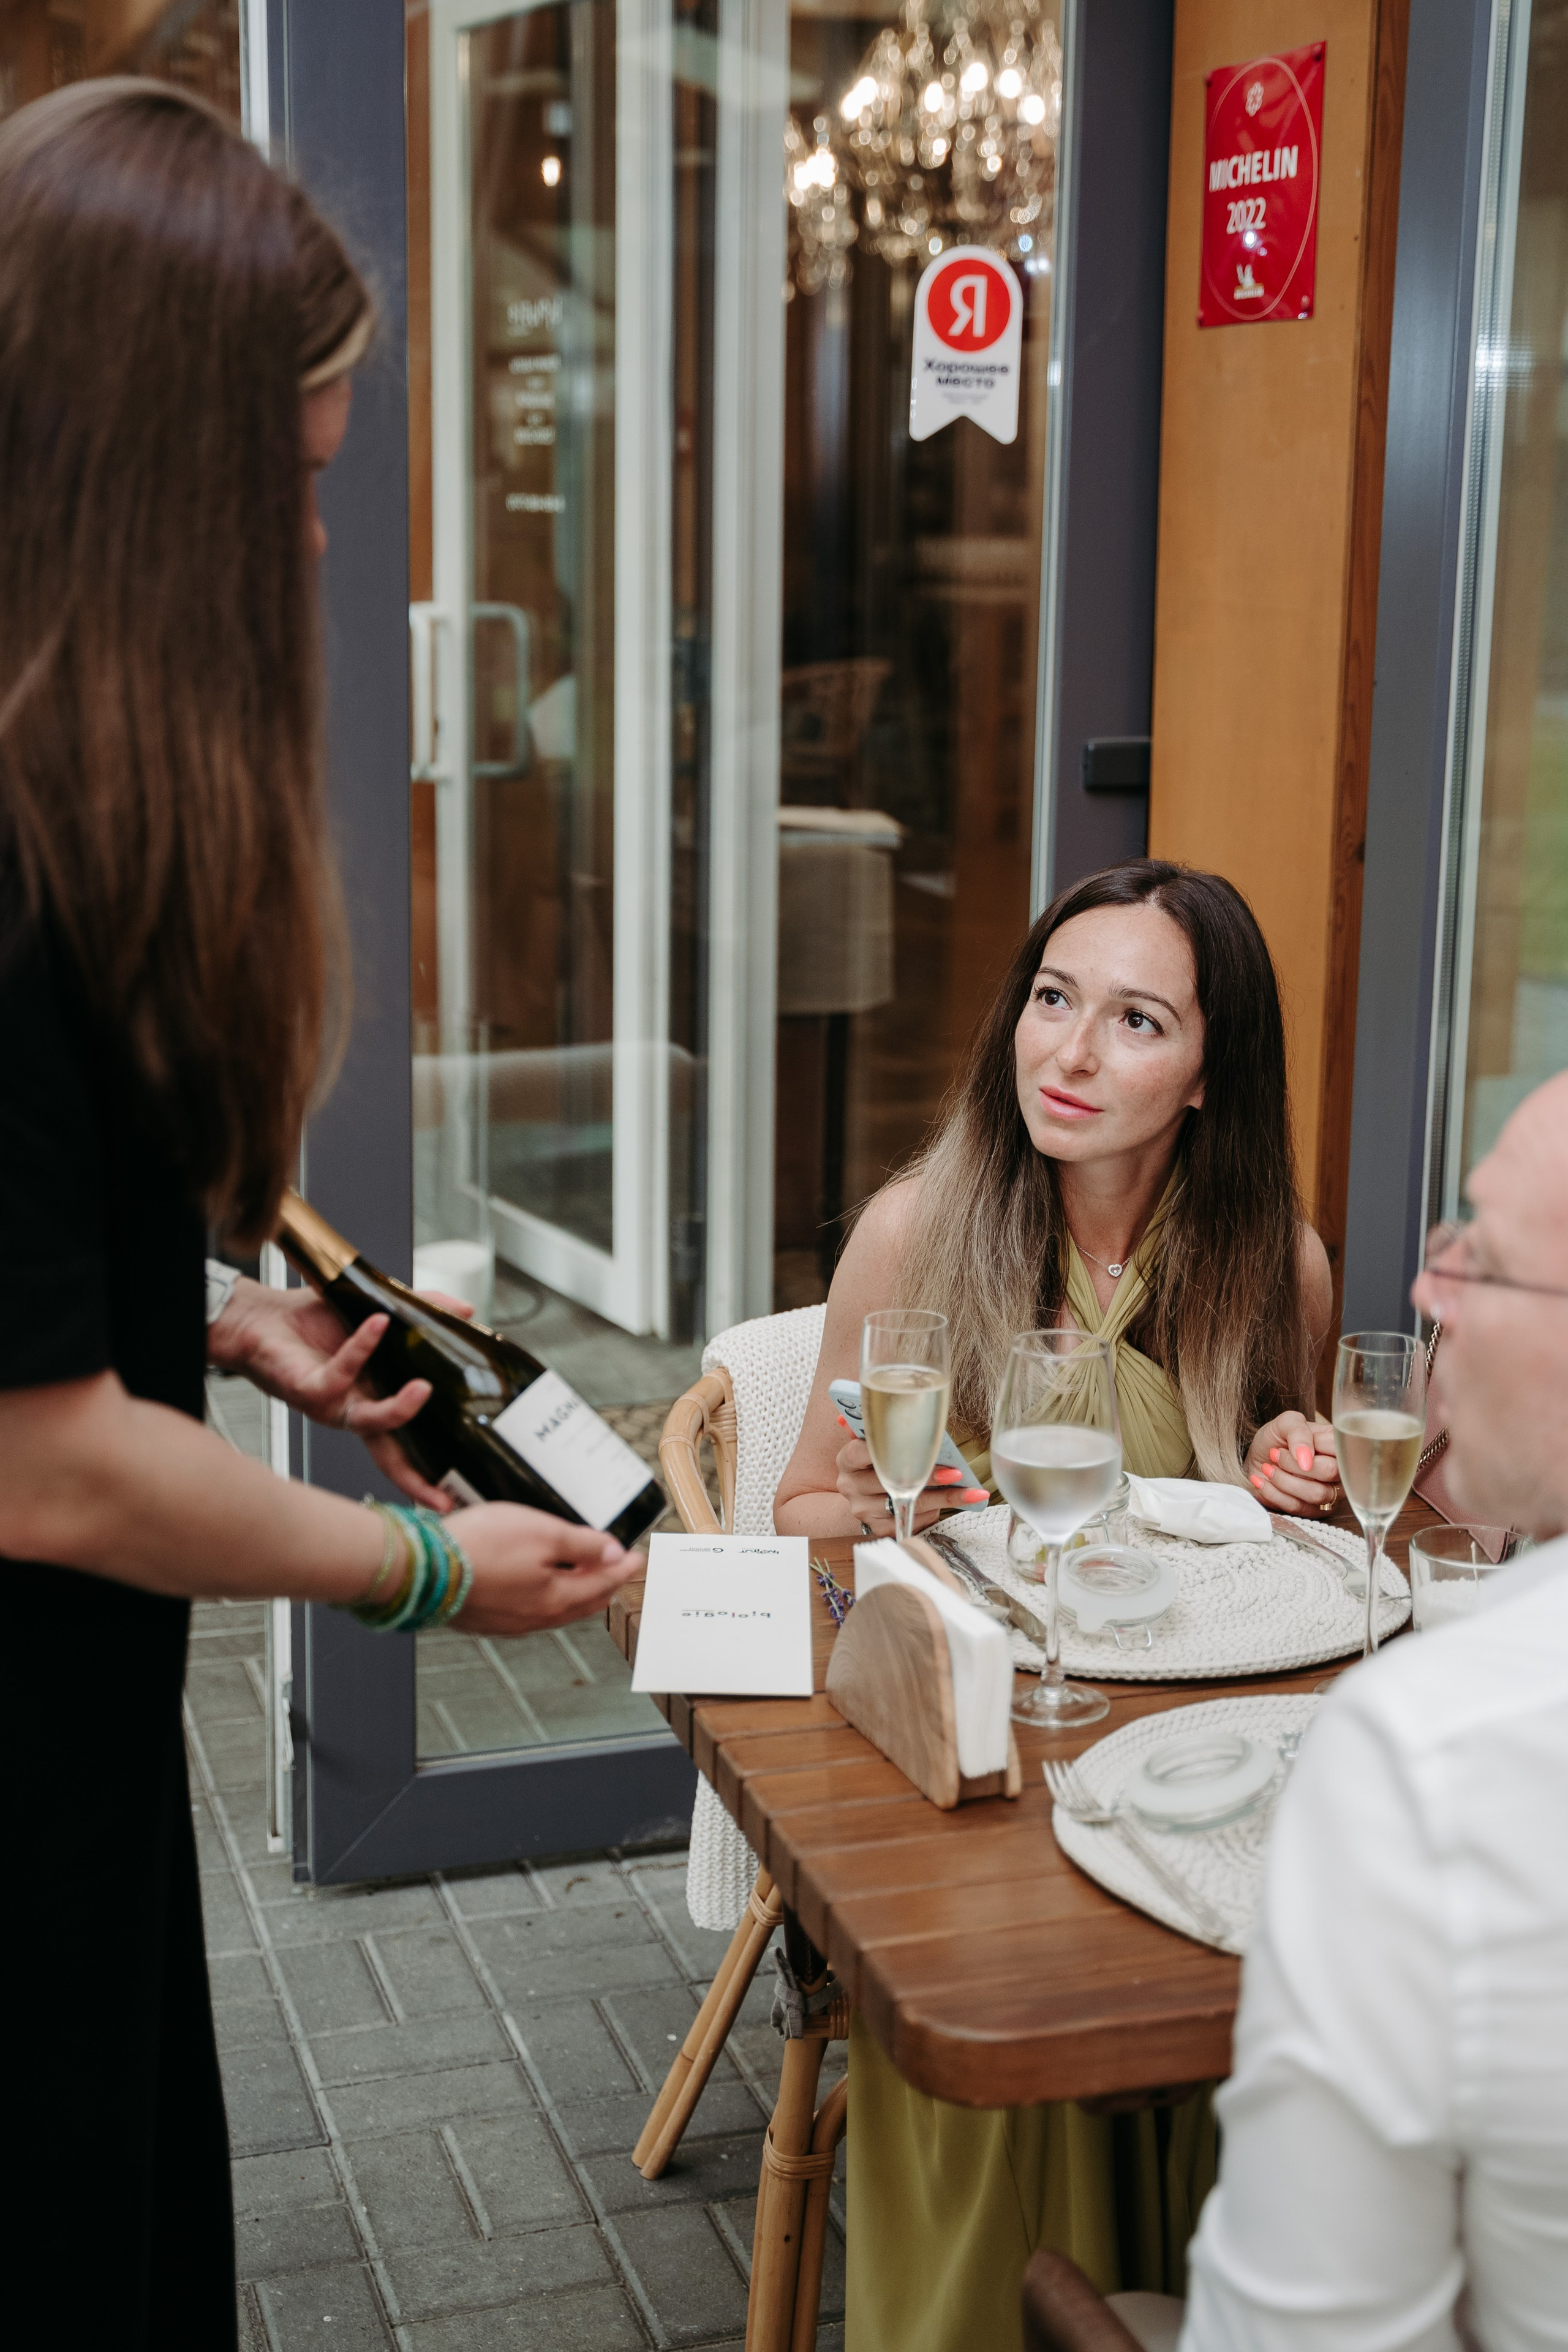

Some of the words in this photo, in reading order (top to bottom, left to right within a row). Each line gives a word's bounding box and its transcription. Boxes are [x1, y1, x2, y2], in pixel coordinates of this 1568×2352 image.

[1208, 145, 1298, 192] MICHELIN
[1226, 197, 1267, 235] 2022
[948, 273, 987, 338] Я
[681, 1610, 771, 1619] biologie
